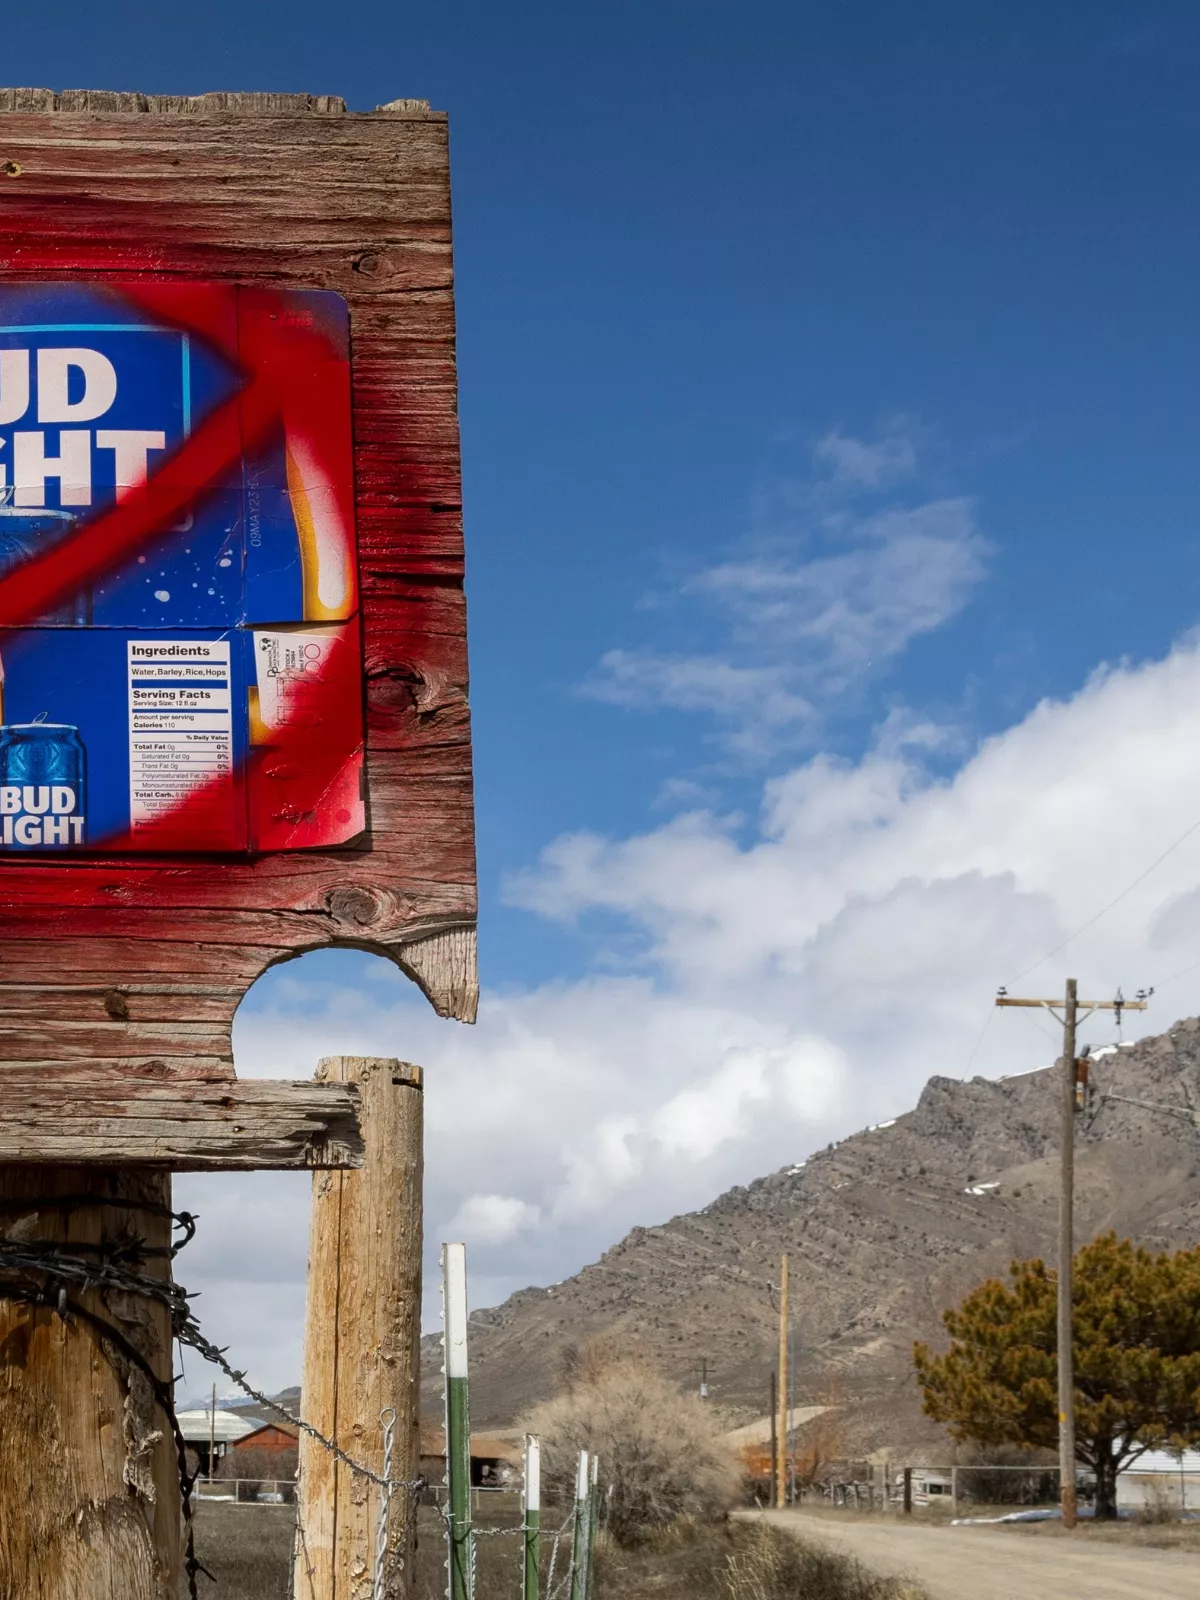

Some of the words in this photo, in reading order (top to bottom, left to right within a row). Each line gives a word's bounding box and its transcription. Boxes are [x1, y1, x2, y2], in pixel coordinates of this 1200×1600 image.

[132, 645, 210, 657] Ingredients
[132, 668, 156, 676] Water,
[157, 668, 185, 677] Barley,
[186, 669, 205, 677] Rice,
[206, 669, 226, 677] Hops
[133, 690, 175, 700] Serving
[180, 690, 211, 698] Facts
[0, 786, 75, 814] BUD
